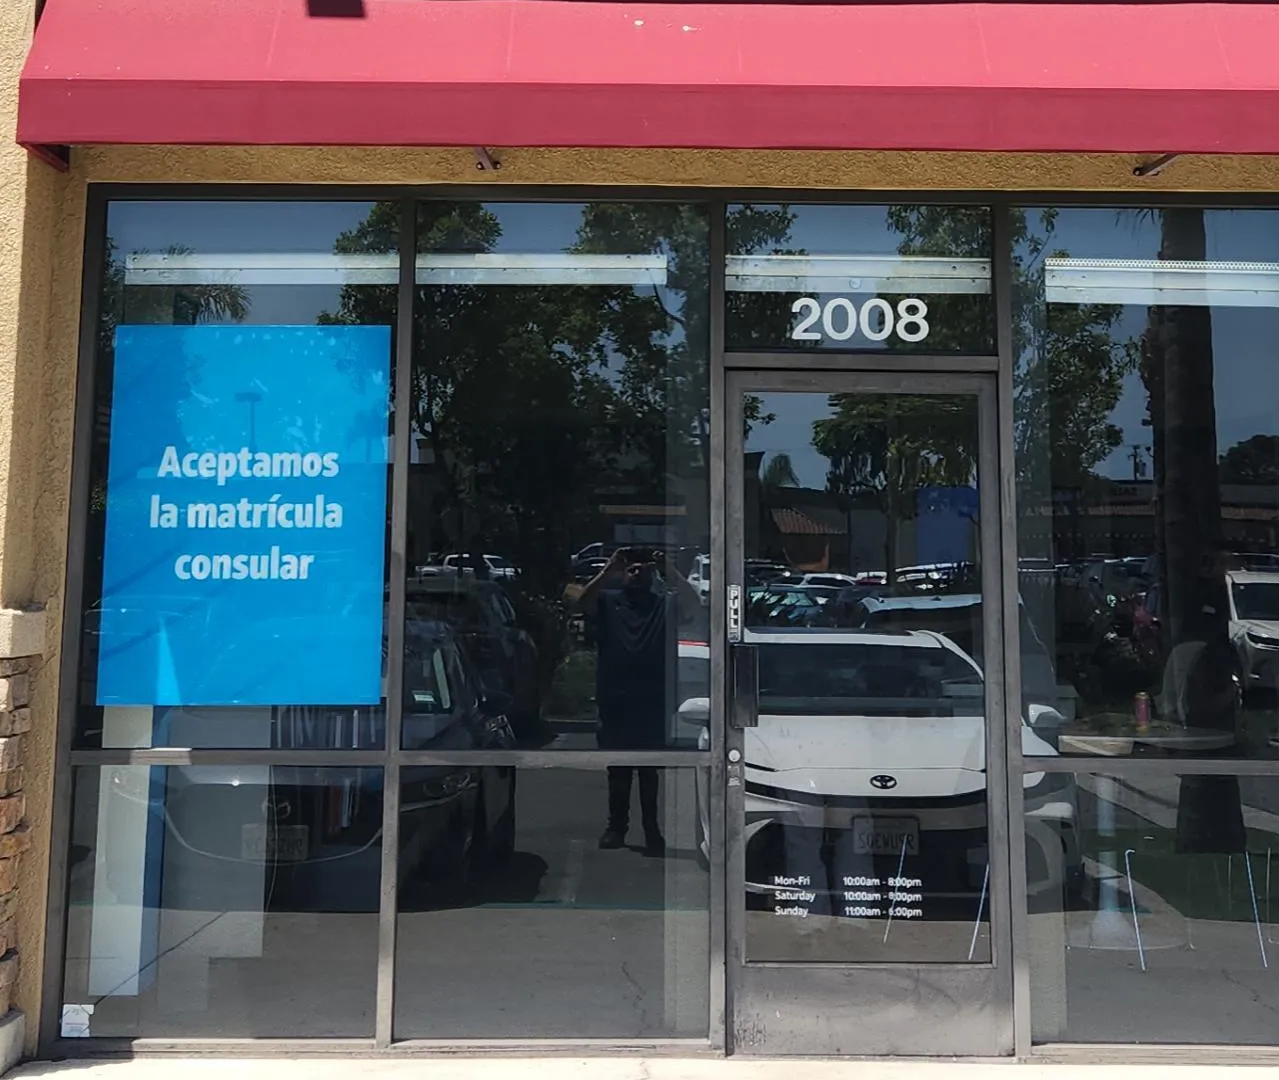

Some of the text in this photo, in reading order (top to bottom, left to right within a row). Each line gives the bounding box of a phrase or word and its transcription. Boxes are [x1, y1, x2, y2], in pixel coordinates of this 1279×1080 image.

[791, 297, 929, 342] 2008
[157, 446, 339, 486] Aceptamos
[150, 493, 343, 529] la matrícula
[174, 545, 314, 580] consular
[729, 589, 739, 628] PULL
[774, 875, 810, 886] Mon-Fri
[842, 876, 880, 886] 10:00am
[887, 876, 922, 889] 8:00pm
[774, 890, 816, 903] Saturday
[844, 891, 881, 901] 10:00am
[774, 905, 809, 918] Sunday
[845, 906, 881, 916] 11:00am
